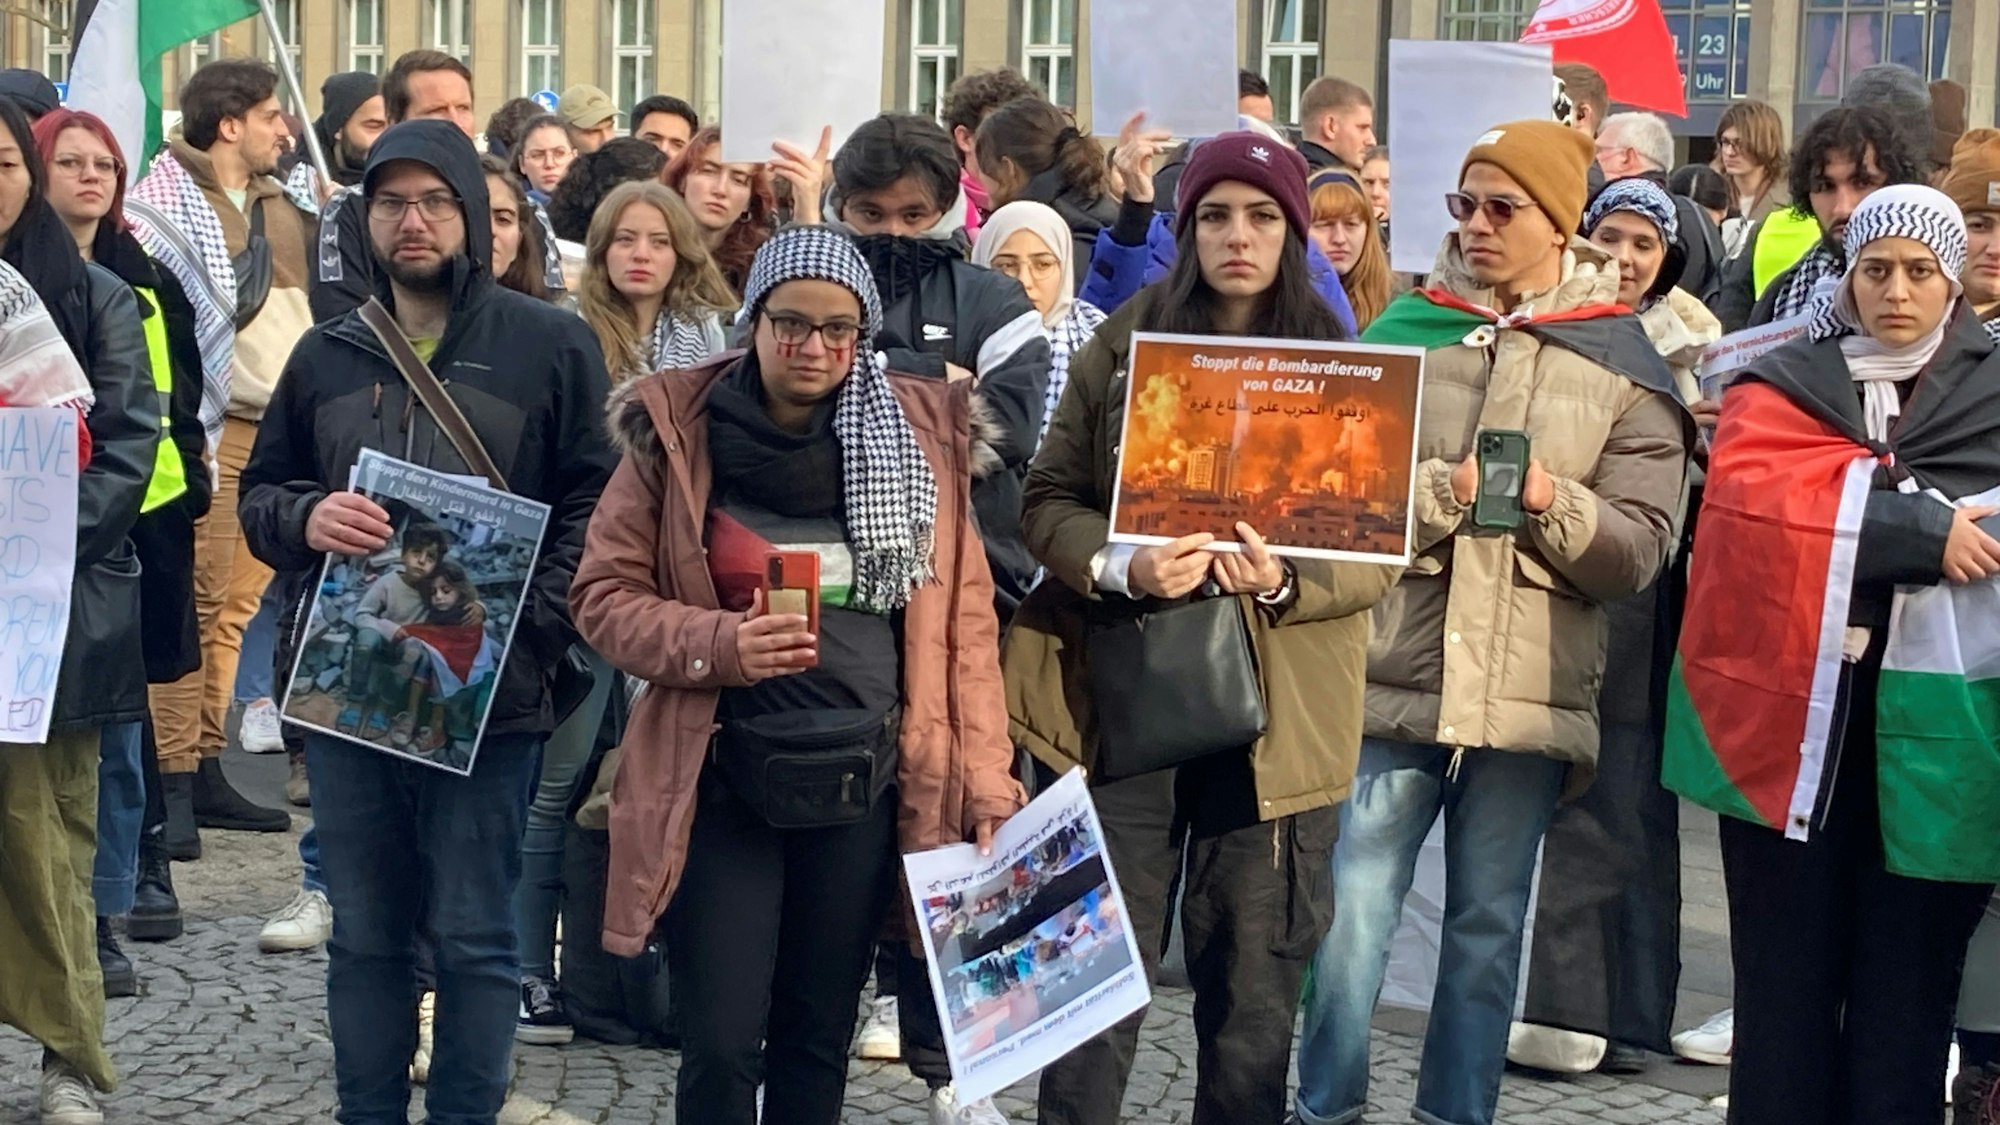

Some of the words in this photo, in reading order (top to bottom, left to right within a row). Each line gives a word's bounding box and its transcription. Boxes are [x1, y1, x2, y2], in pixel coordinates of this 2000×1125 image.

[1699, 34, 1725, 55] 23
[1695, 72, 1724, 90] Uhr
[1191, 353, 1238, 373] Stoppt
[1242, 356, 1264, 371] die
[1267, 358, 1383, 381] Bombardierung
[1243, 378, 1268, 392] von
[1272, 378, 1315, 394] GAZA
[1318, 380, 1326, 395] !
[1252, 402, 1279, 416] على
[1283, 403, 1325, 419] الحرب
[367, 458, 406, 478] Stoppt
[405, 469, 428, 487] den
[429, 476, 499, 507] Kindermord
[499, 497, 512, 511] in
[514, 503, 544, 520] Gaza
[0, 697, 45, 733] ED
[1067, 1003, 1083, 1019] mit
[1044, 1014, 1066, 1031] dem
